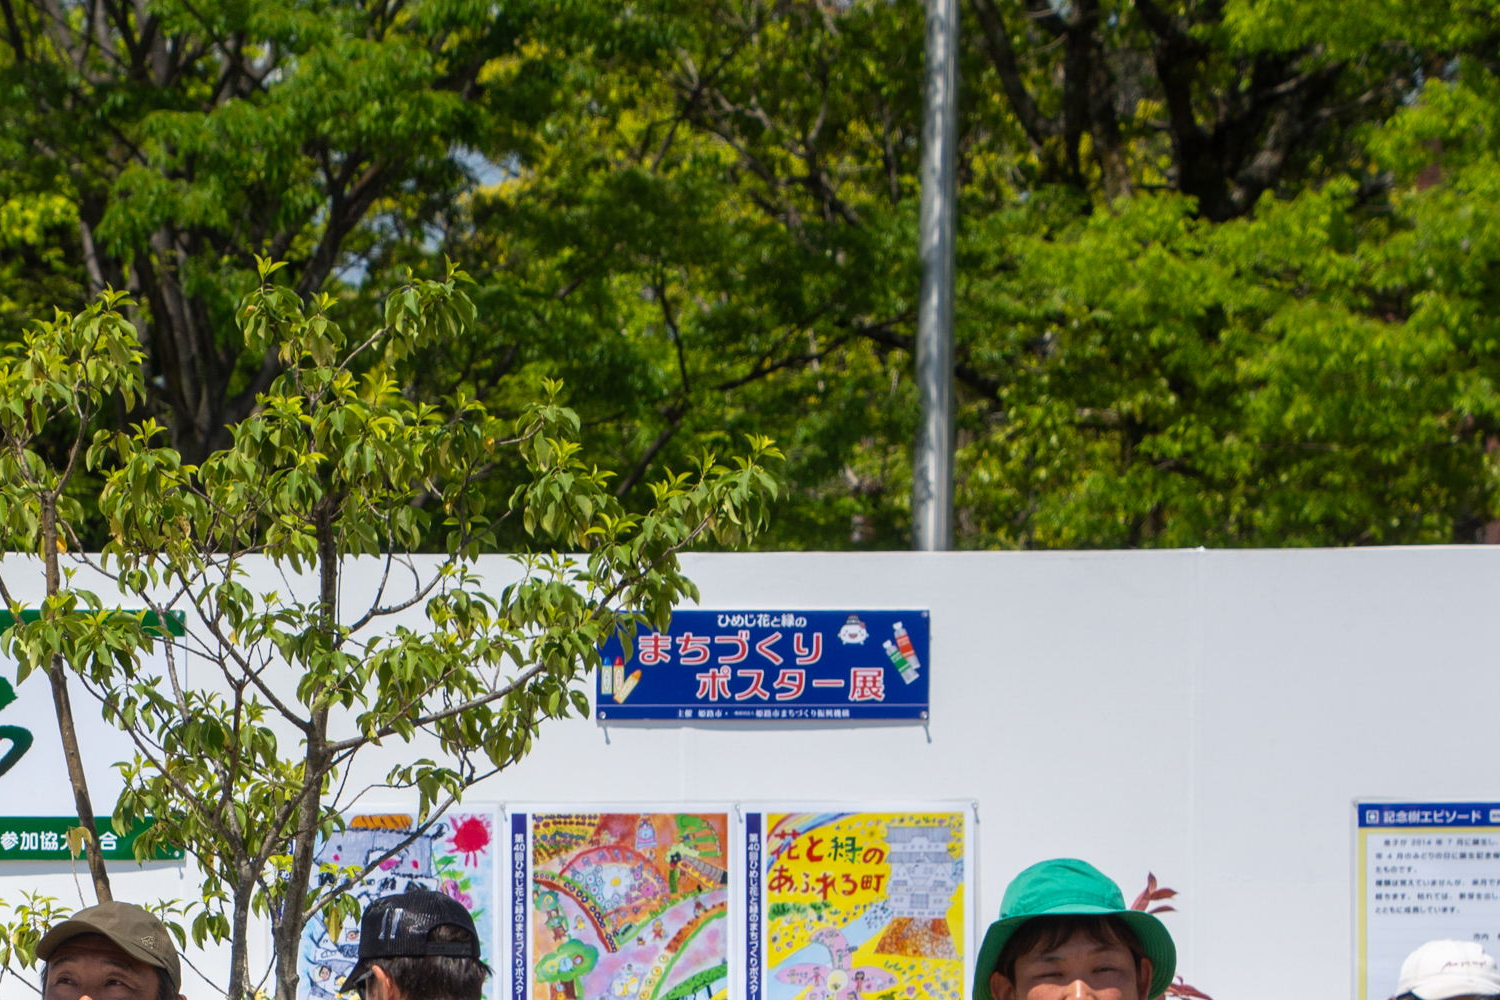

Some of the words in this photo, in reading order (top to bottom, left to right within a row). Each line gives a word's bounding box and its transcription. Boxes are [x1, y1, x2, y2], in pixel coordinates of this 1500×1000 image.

[717, 614, 808, 628] ひめじ花と緑の
[638, 631, 823, 666] まちづくり
[696, 664, 886, 702] ポスター展
[1383, 809, 1482, 824] 記念樹エピソード
[770, 829, 885, 865] 花と緑の
[768, 864, 886, 901] あふれる町
